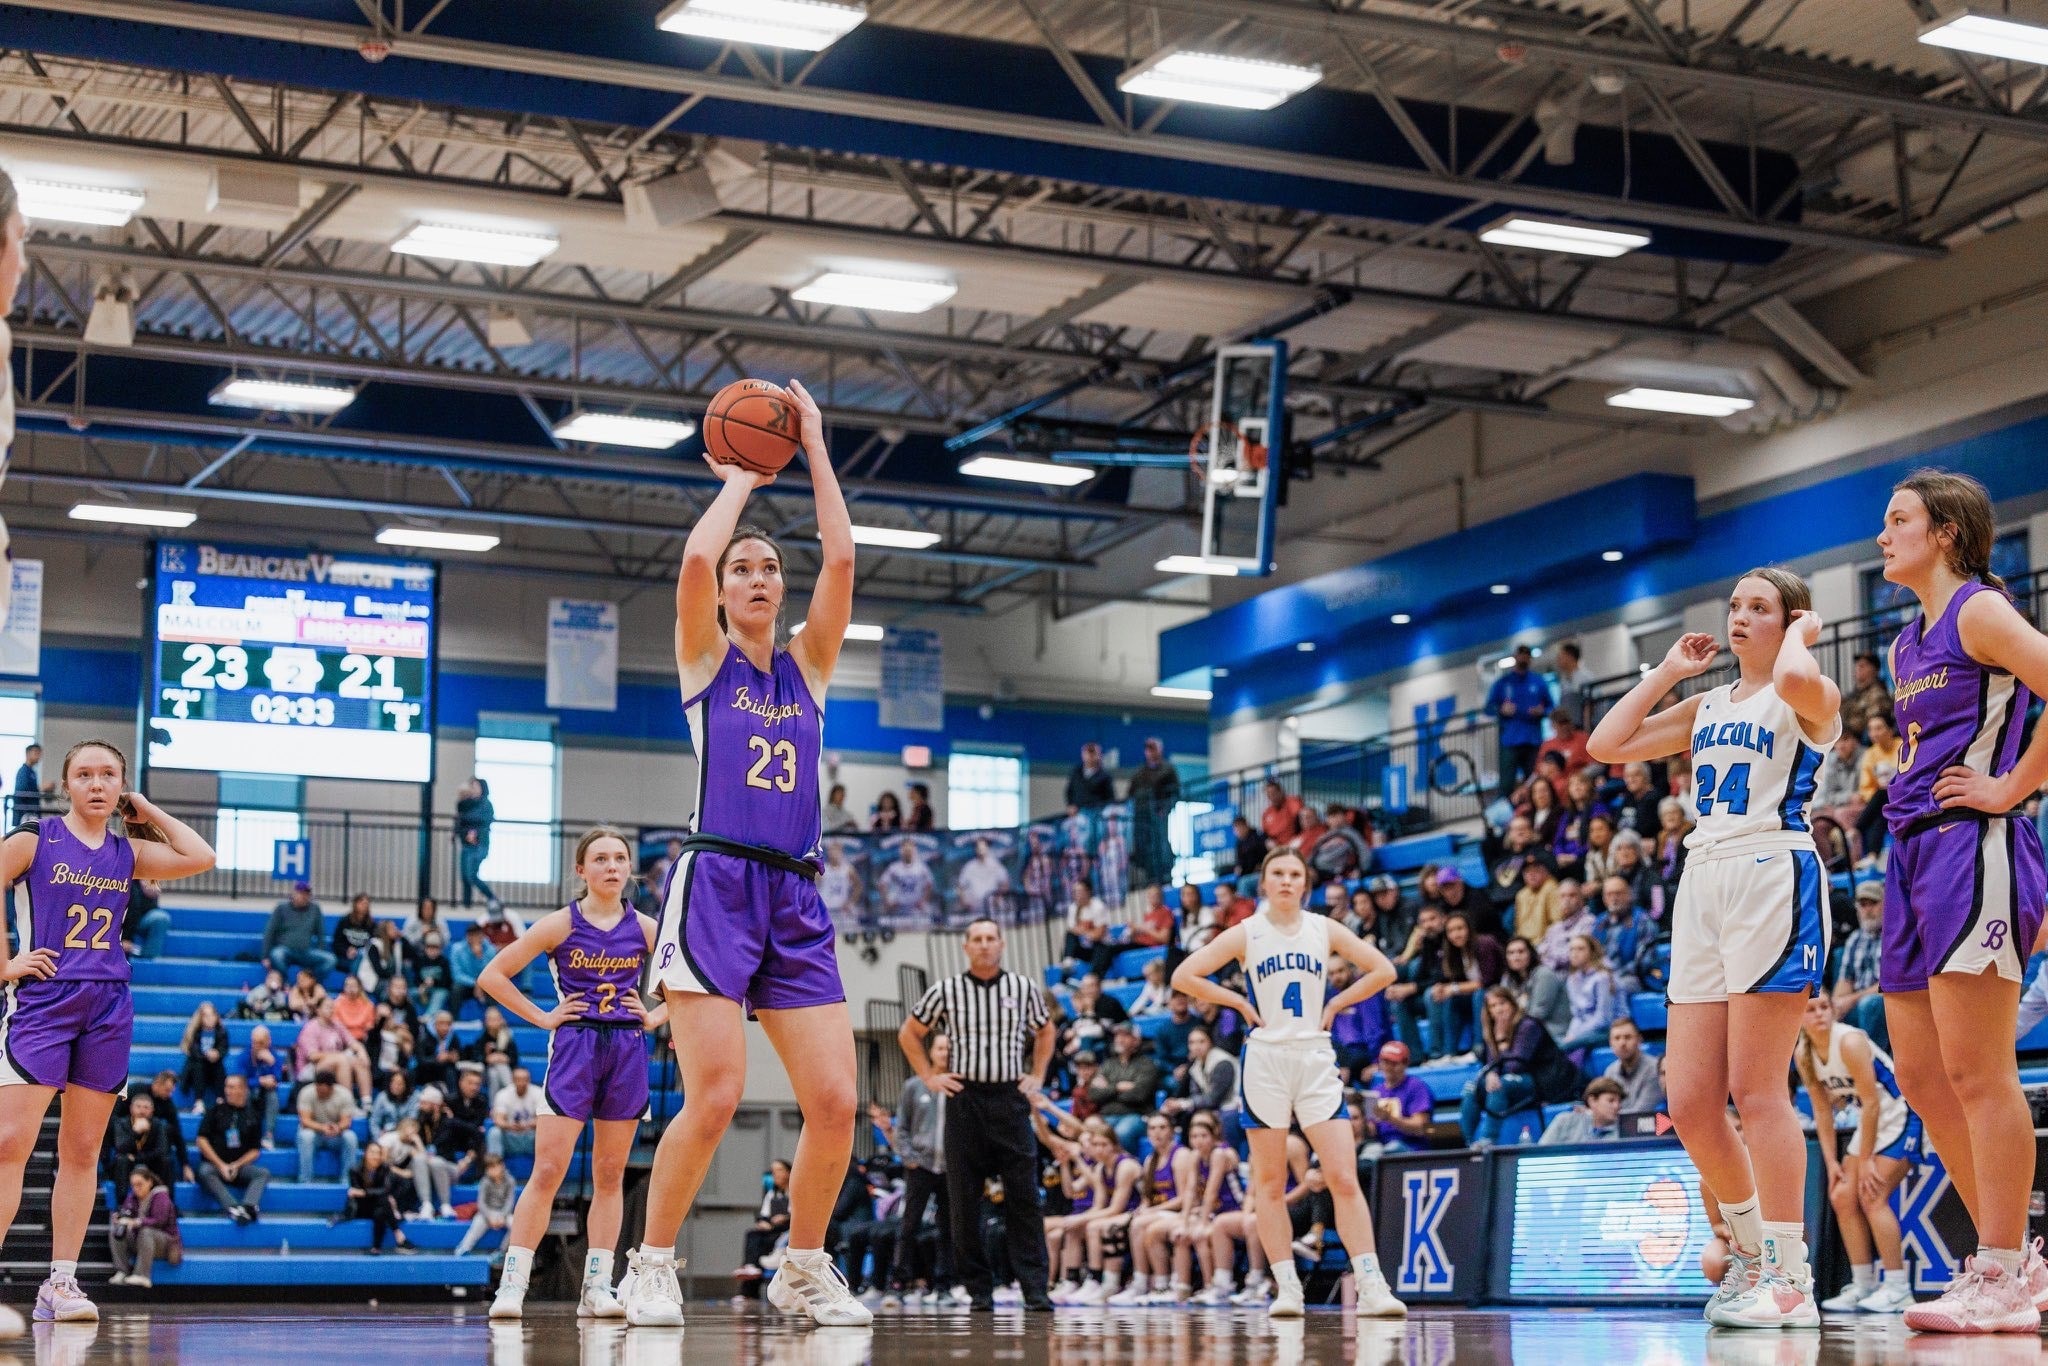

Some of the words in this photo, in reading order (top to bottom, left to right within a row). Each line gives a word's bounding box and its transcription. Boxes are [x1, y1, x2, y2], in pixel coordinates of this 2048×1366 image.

[164, 614, 263, 632] MALCOLM
[181, 643, 249, 691] 23
[339, 654, 404, 702] 21
[250, 693, 335, 727] 02:33
[746, 733, 797, 793] 23
[1695, 763, 1751, 817] 24
[279, 842, 305, 876] H
[49, 862, 129, 896] Bridgeport
[64, 903, 114, 950] 22
[1981, 919, 2008, 951] B
[568, 948, 640, 977] Bridgeport
[1256, 951, 1323, 983] MALCOLM
[1803, 944, 1818, 971] M
[596, 982, 617, 1014] 2
[1281, 981, 1304, 1018] 4
[1396, 1168, 1460, 1293] K
